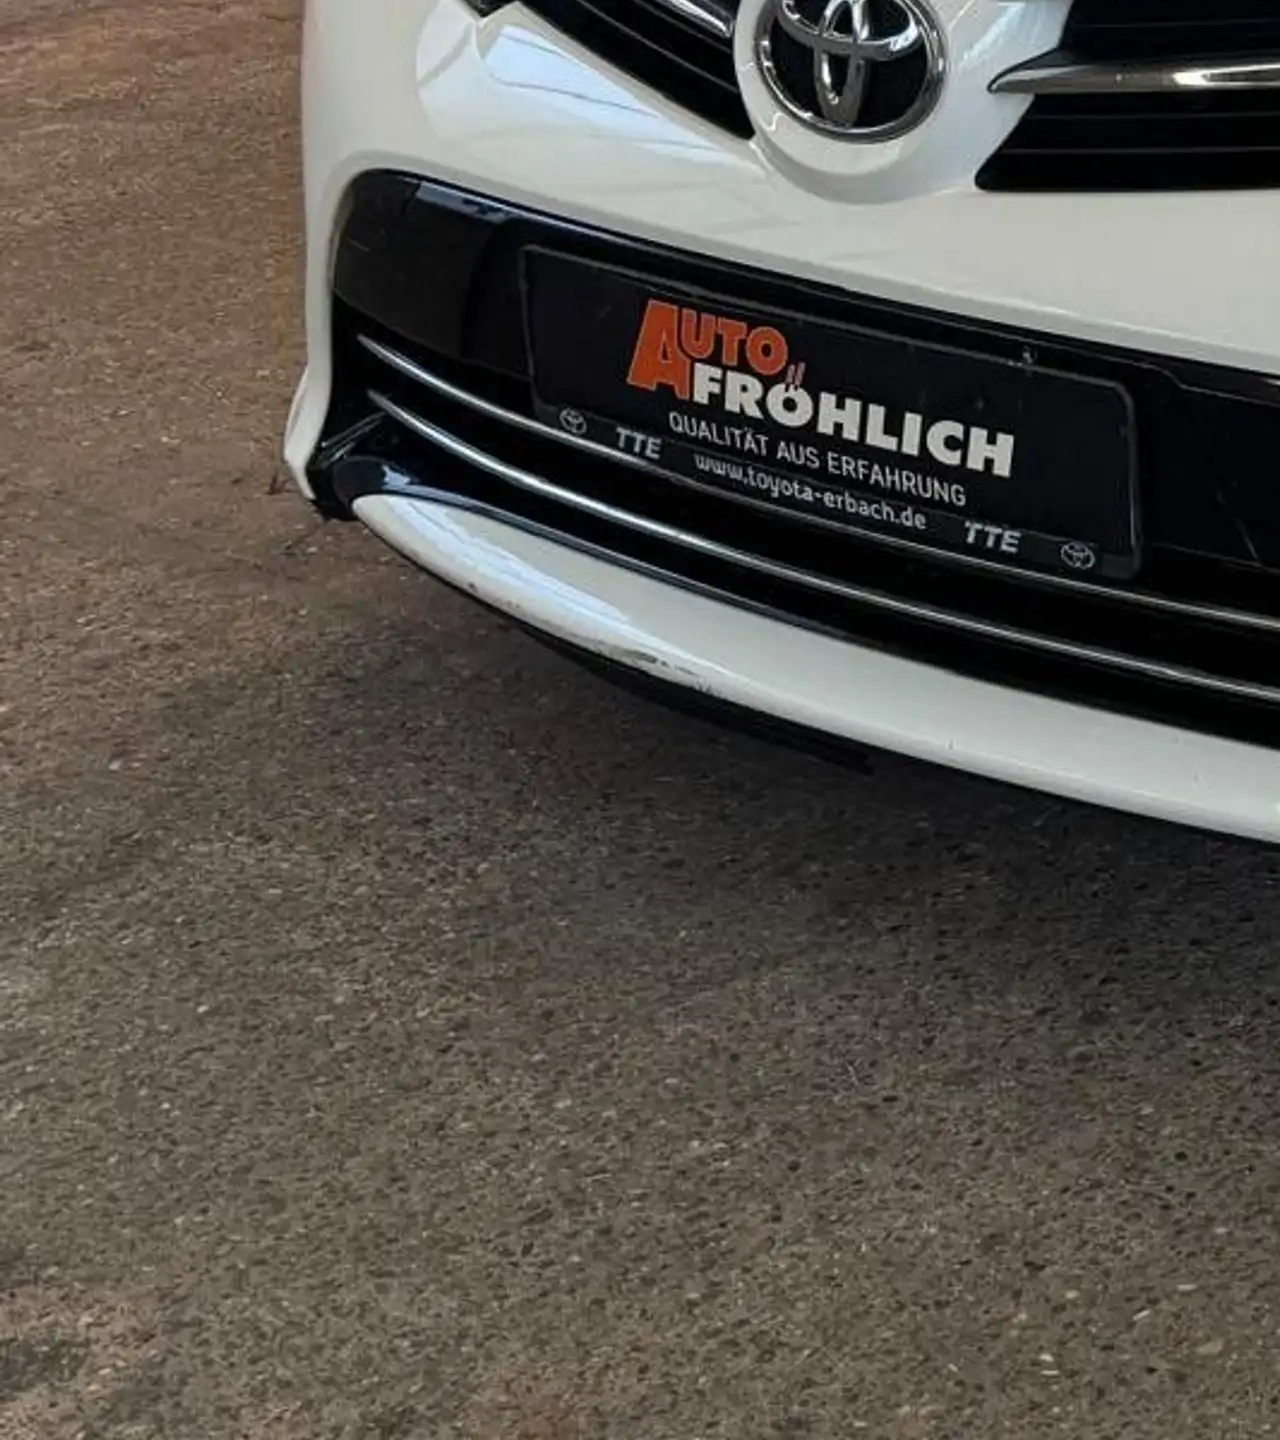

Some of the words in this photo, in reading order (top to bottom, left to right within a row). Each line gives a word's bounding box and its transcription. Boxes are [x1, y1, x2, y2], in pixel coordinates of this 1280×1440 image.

[626, 299, 789, 401] AUTO
[668, 411, 769, 456] QUALITÄT
[776, 440, 820, 469] AUS
[826, 451, 967, 507] ERFAHRUNG
[693, 362, 1015, 478] FRÖHLICH
[616, 426, 664, 459] TTE
[693, 453, 928, 530] www.toyota-erbach.de
[963, 519, 1022, 554] TTE
